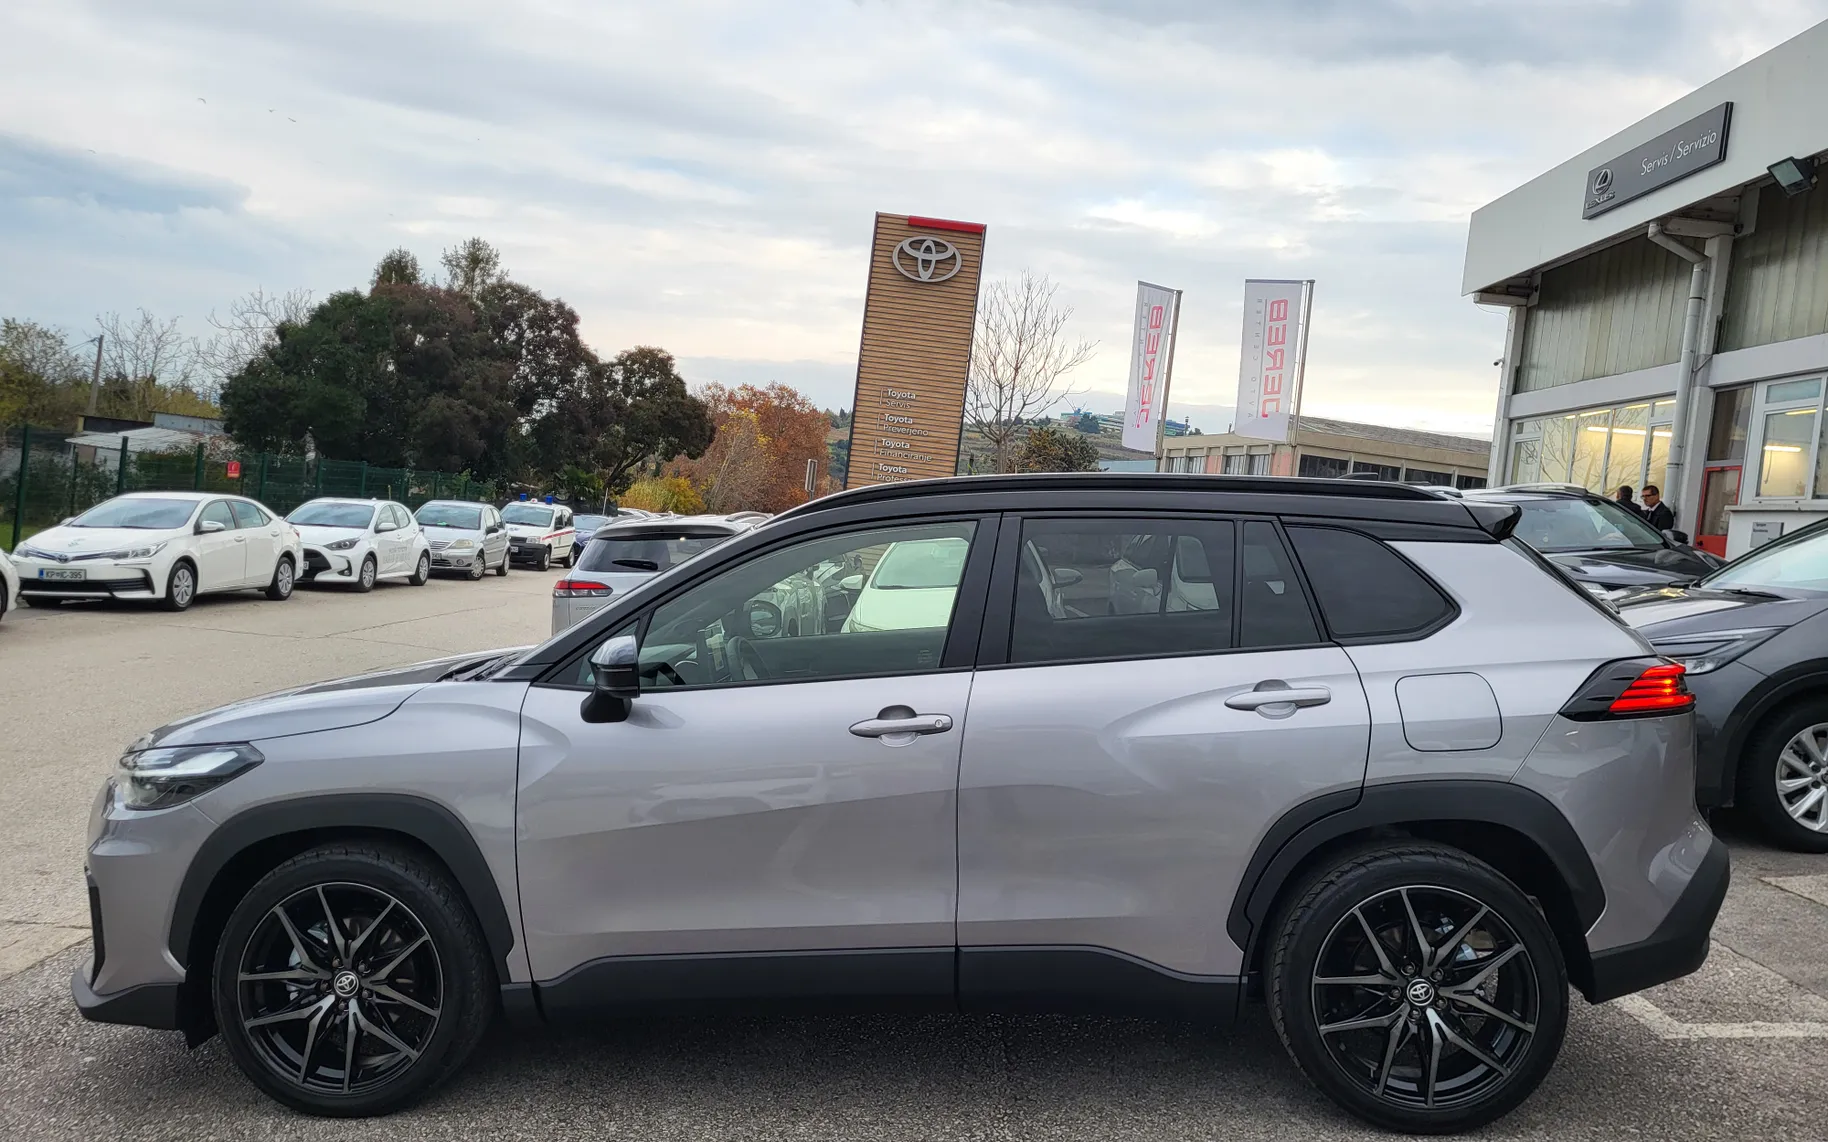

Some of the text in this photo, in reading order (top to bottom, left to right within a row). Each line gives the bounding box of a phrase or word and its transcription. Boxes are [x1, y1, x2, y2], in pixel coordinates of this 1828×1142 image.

[887, 388, 916, 400] Toyota
[885, 399, 911, 409] Servis
[884, 413, 913, 424] Toyota
[883, 424, 929, 436] Preverjeno
[881, 438, 910, 449] Toyota
[878, 463, 908, 474] Toyota
